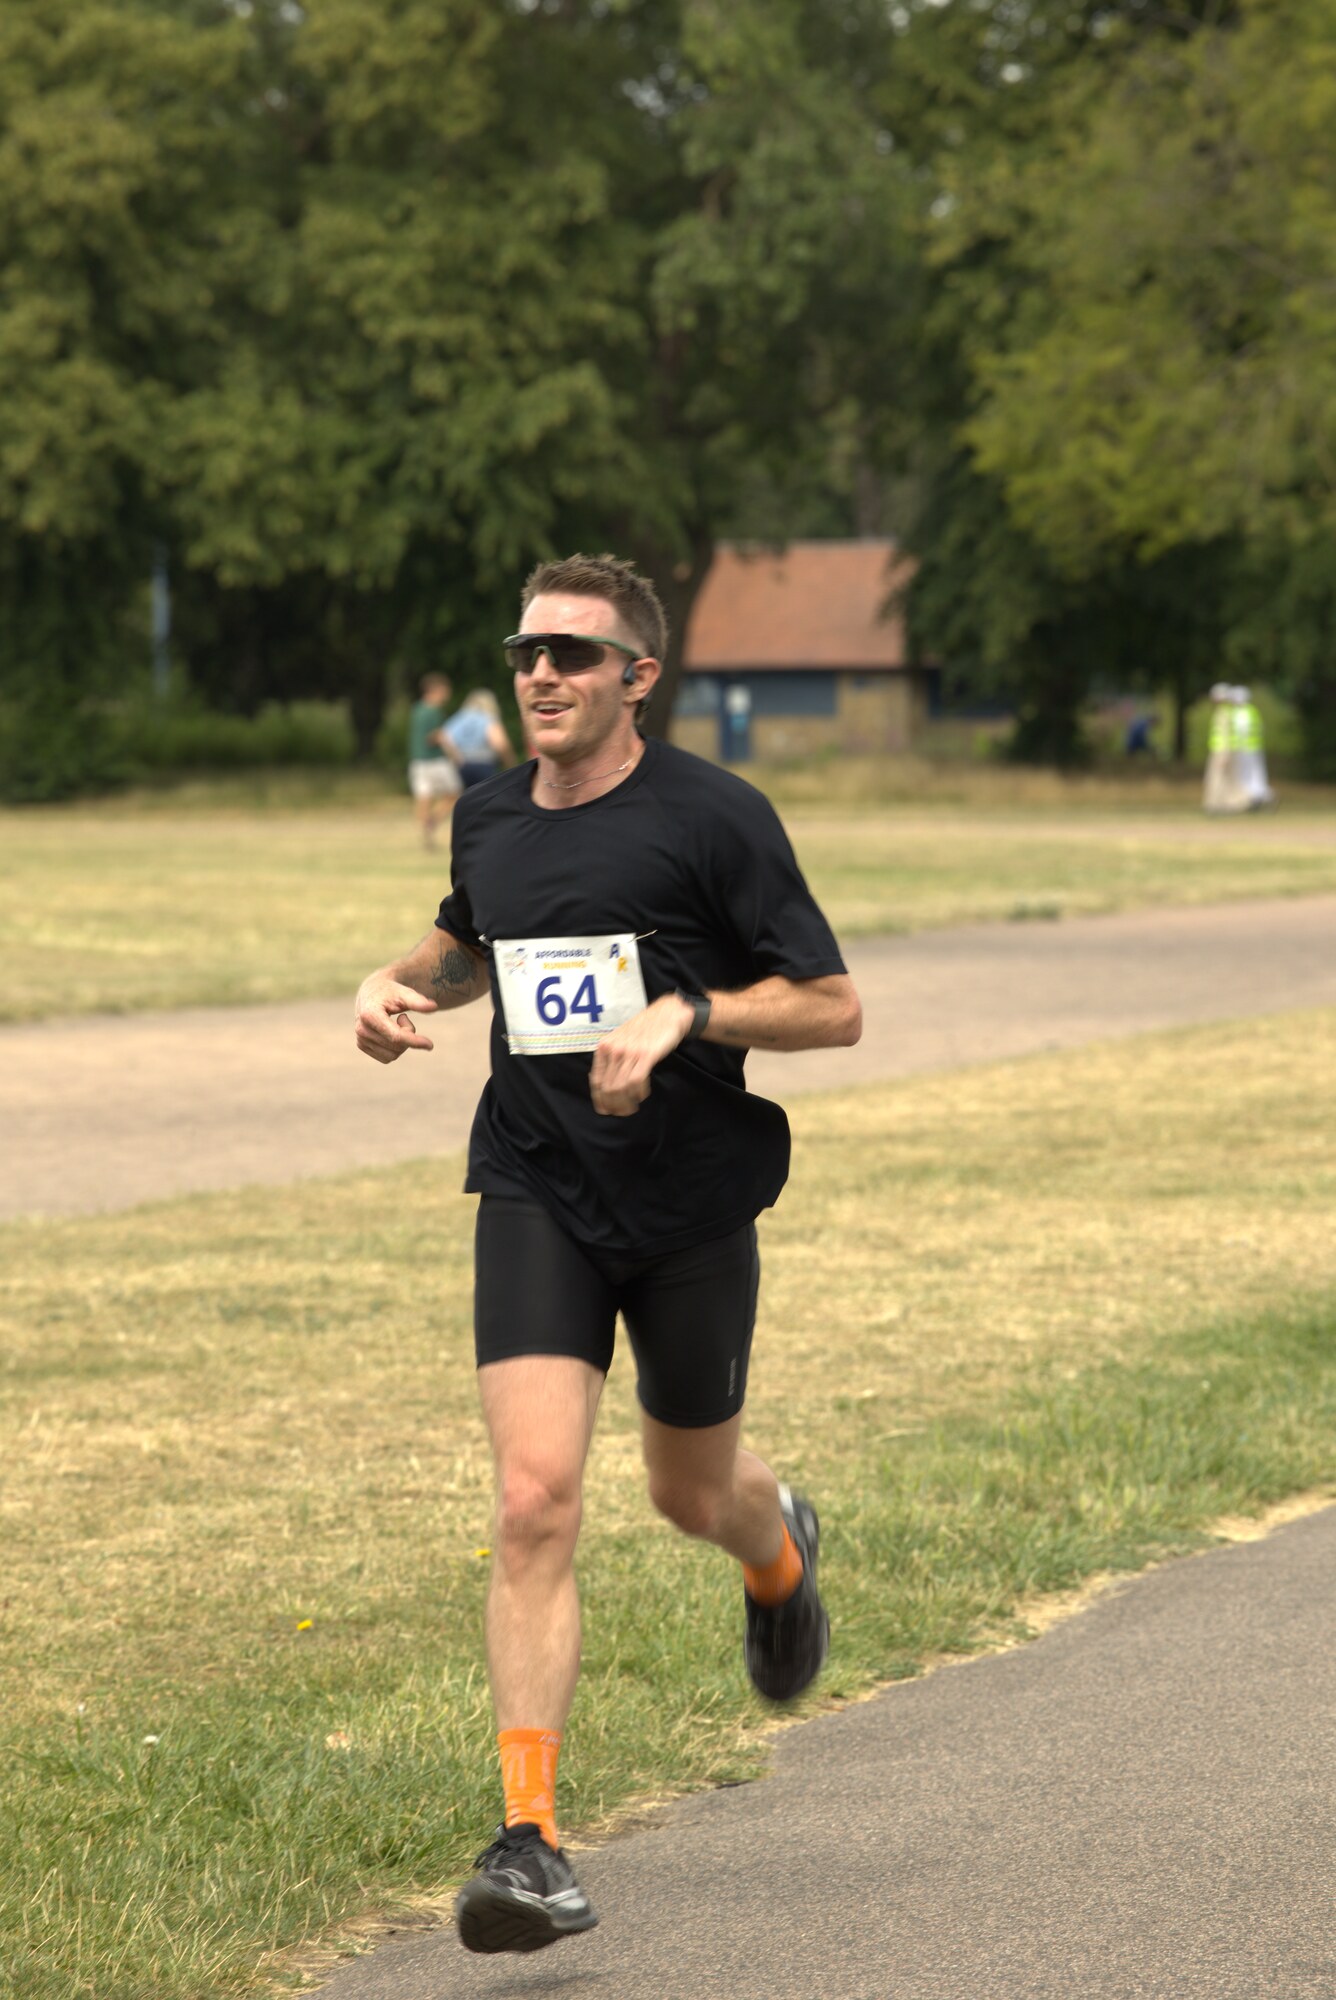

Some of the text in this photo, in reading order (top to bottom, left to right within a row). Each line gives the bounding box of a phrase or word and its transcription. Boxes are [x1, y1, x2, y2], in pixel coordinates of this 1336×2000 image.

[535, 948, 592, 959] AFFORDABLE
[609, 943, 620, 959] A
[536, 974, 604, 1026] 64
